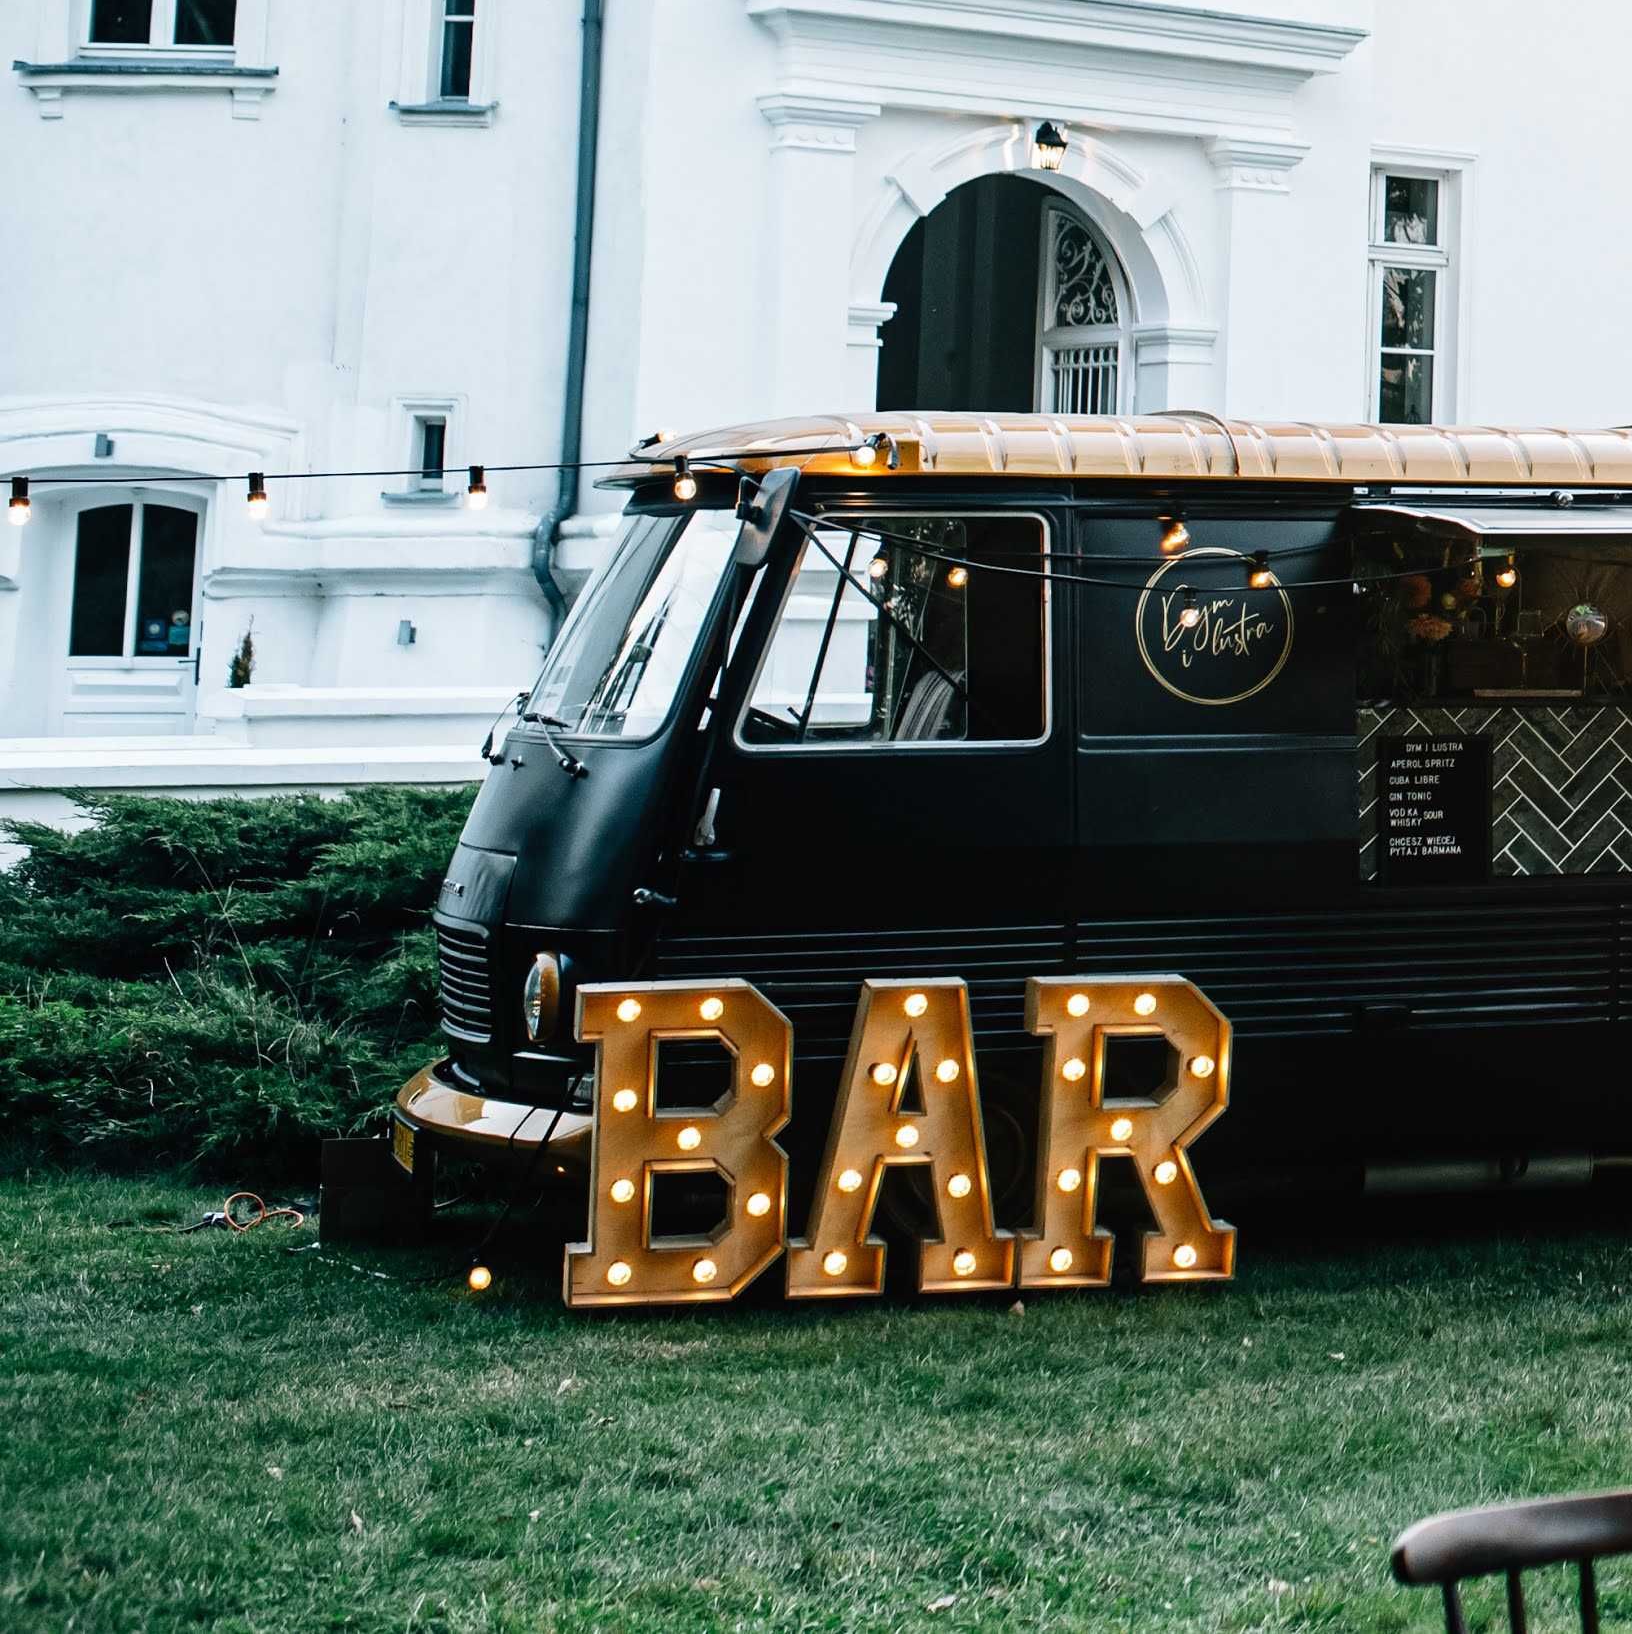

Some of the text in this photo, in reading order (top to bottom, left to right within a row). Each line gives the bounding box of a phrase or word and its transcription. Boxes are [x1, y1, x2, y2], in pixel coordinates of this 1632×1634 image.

[1212, 602, 1273, 656] lustra
[1406, 743, 1422, 752] DYM
[1432, 742, 1463, 752] LUSTRA
[1390, 758, 1455, 769] APEROL SPRITZ
[1389, 775, 1440, 785] CUBA LIBRE
[1389, 791, 1432, 801] GIN TONIC
[1423, 810, 1443, 820] SOUR
[1390, 818, 1422, 827] WHISKY
[1389, 835, 1455, 846] CHCESZ WIECEJ
[1390, 845, 1461, 856] PYTAJ BARMANA
[563, 974, 1236, 1308] BAR
